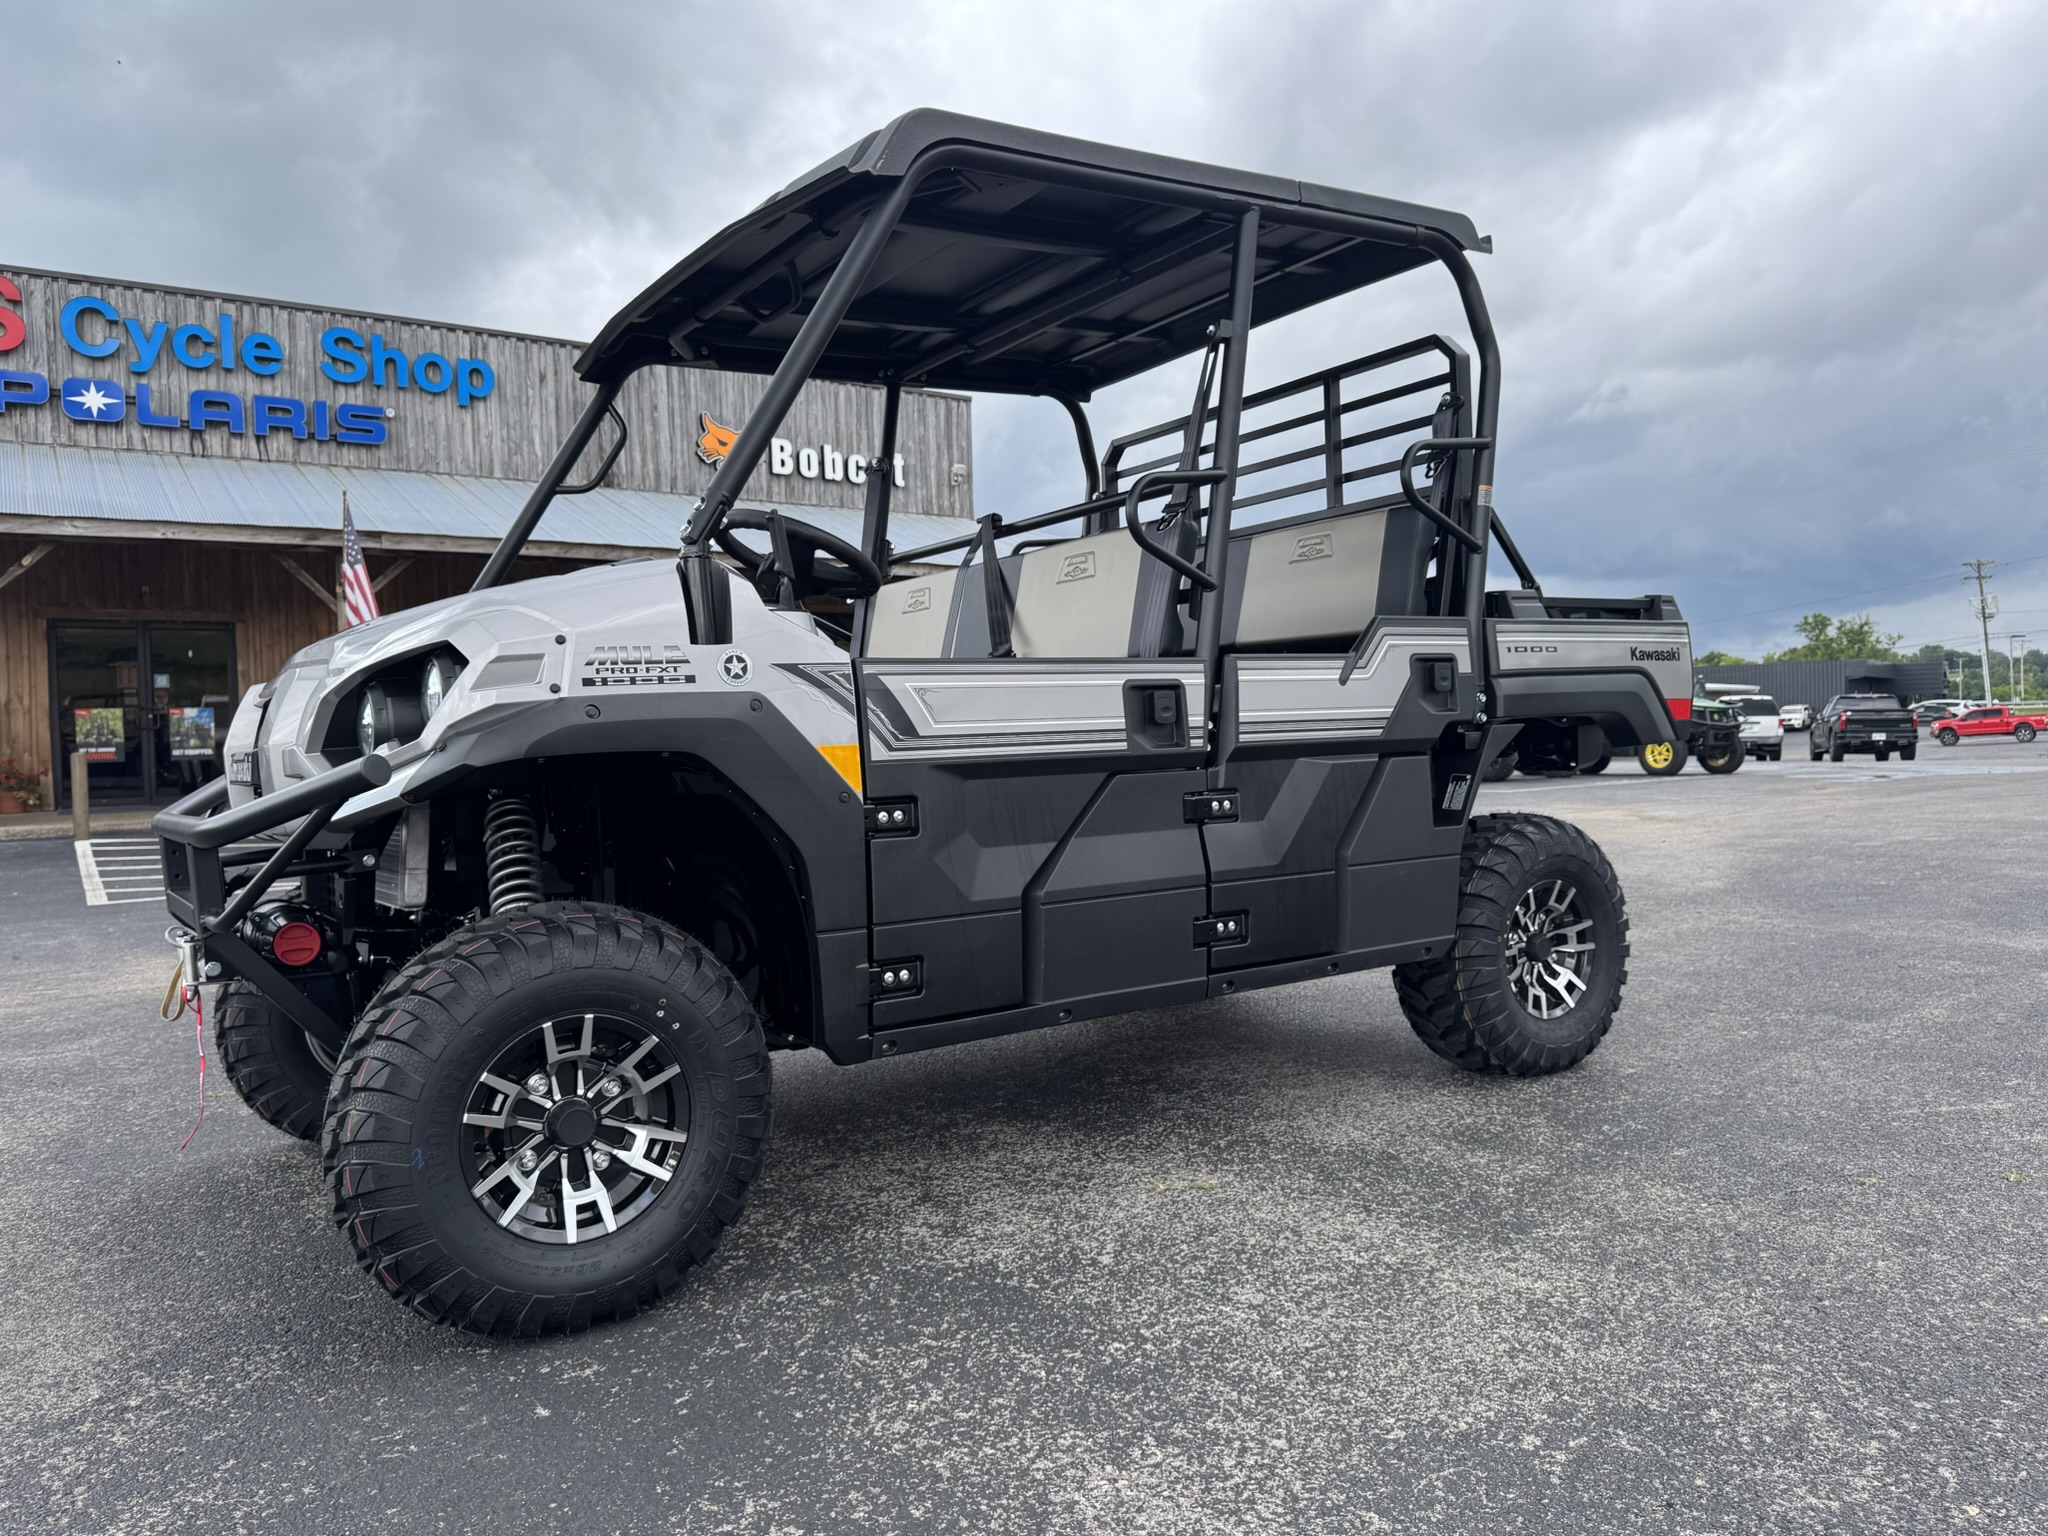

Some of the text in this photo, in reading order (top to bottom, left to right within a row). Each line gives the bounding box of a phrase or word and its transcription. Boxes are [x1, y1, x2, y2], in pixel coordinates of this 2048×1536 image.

[60, 296, 284, 377] Cycle
[320, 327, 496, 407] Shop
[0, 370, 389, 446] POLARIS
[770, 437, 905, 488] Bobct
[584, 645, 691, 666] MULE
[595, 666, 682, 674] PRO-FXT
[1506, 645, 1681, 662] 1000 Kawasaki
[592, 676, 687, 686] 1000
[676, 1071, 730, 1223] DURO
